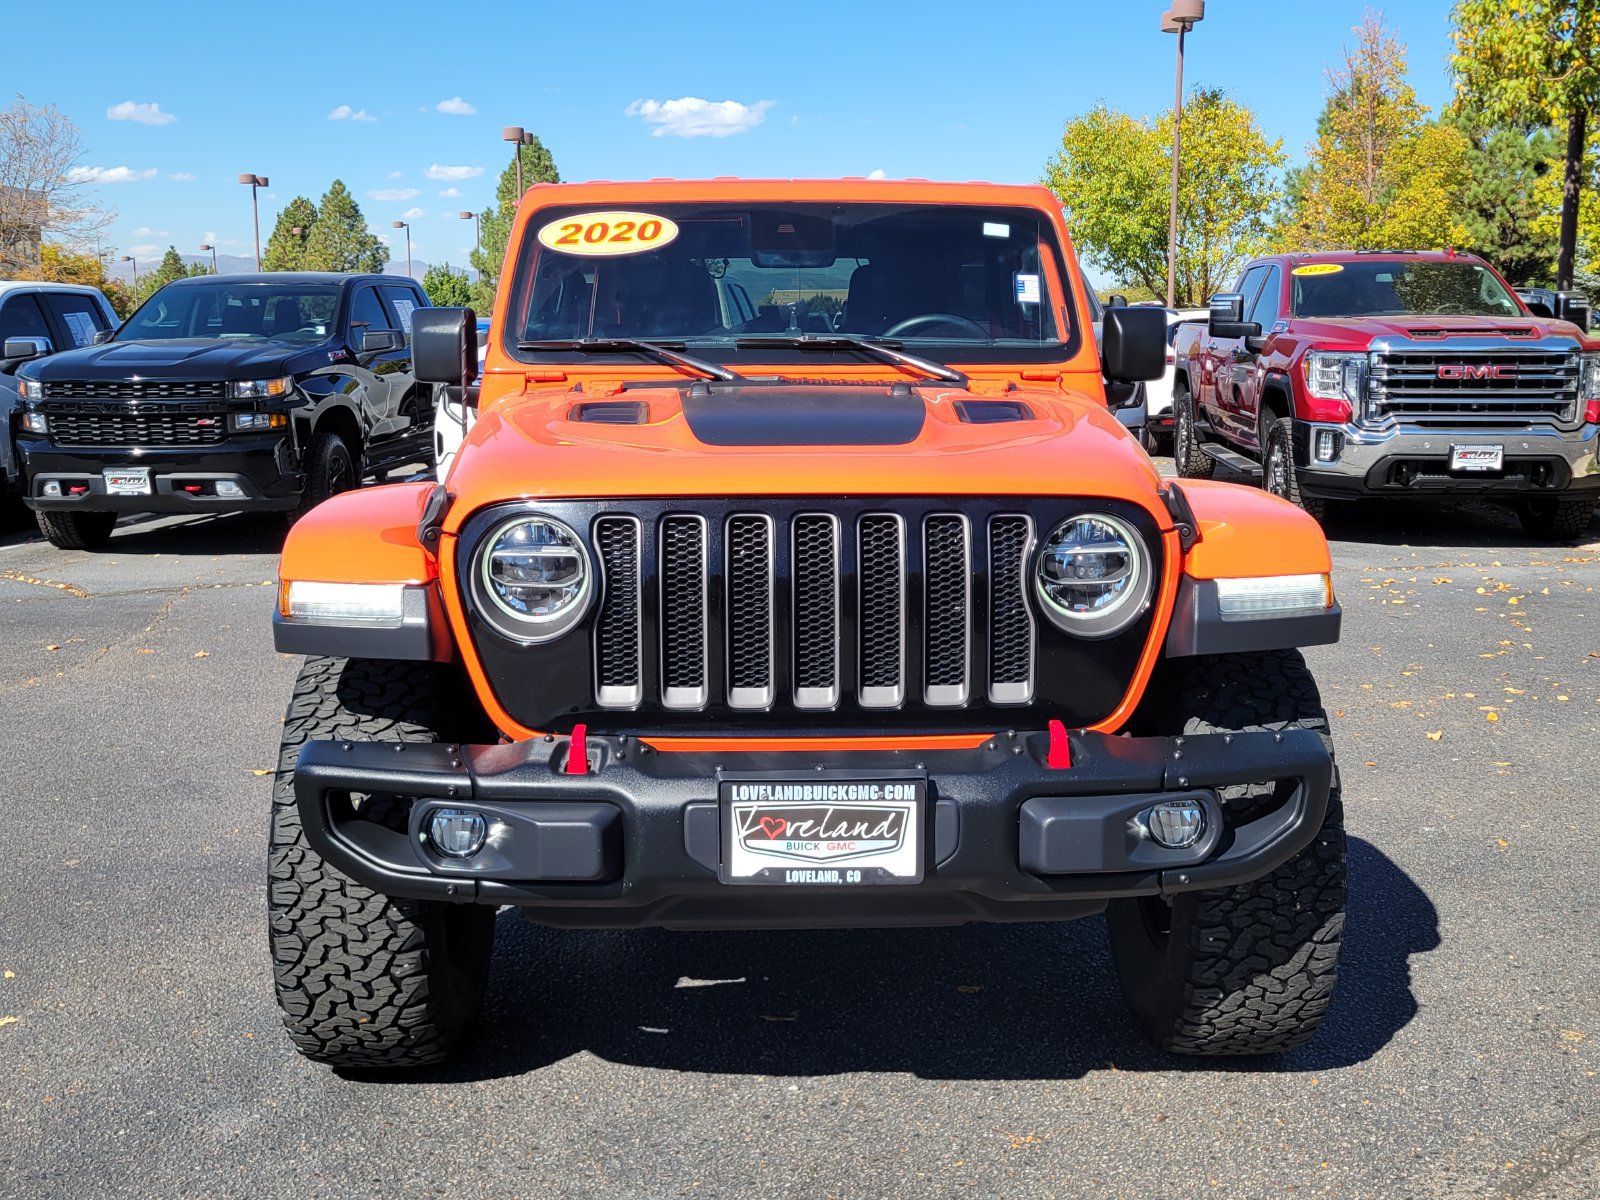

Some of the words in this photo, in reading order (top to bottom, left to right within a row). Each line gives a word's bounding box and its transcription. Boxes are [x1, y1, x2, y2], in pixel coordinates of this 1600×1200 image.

[555, 220, 662, 245] 2020
[1438, 365, 1517, 380] GMC
[731, 784, 916, 800] LOVELANDBUICKGMCCOM
[738, 805, 899, 840] Loveland
[786, 842, 820, 851] BUICK
[826, 841, 856, 851] GMC
[785, 869, 843, 884] LOVELAND,
[846, 871, 861, 883] CO
